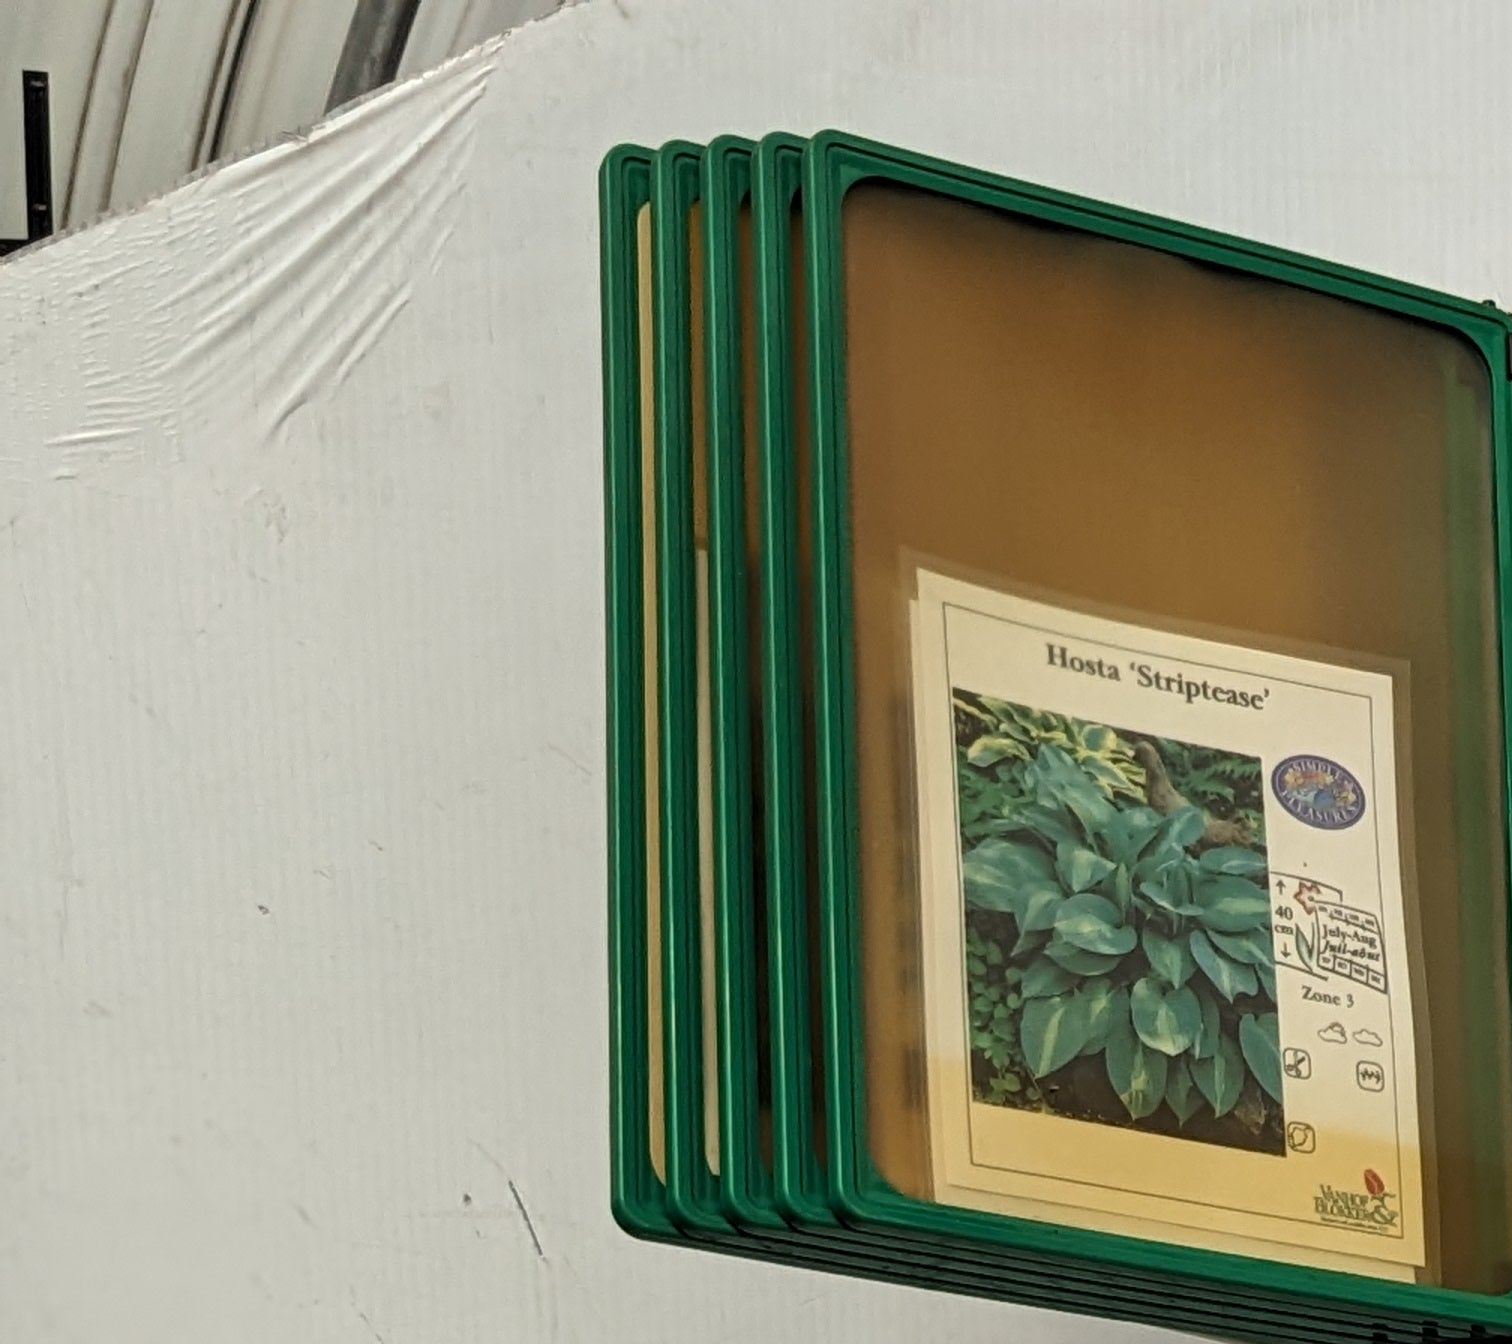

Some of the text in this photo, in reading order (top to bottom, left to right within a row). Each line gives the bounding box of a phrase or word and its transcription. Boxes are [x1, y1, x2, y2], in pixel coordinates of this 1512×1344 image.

[1045, 642, 1122, 682] Hosta
[1275, 905, 1294, 921] 40
[1274, 924, 1294, 935] cm
[1301, 984, 1355, 1008] Zone 3
